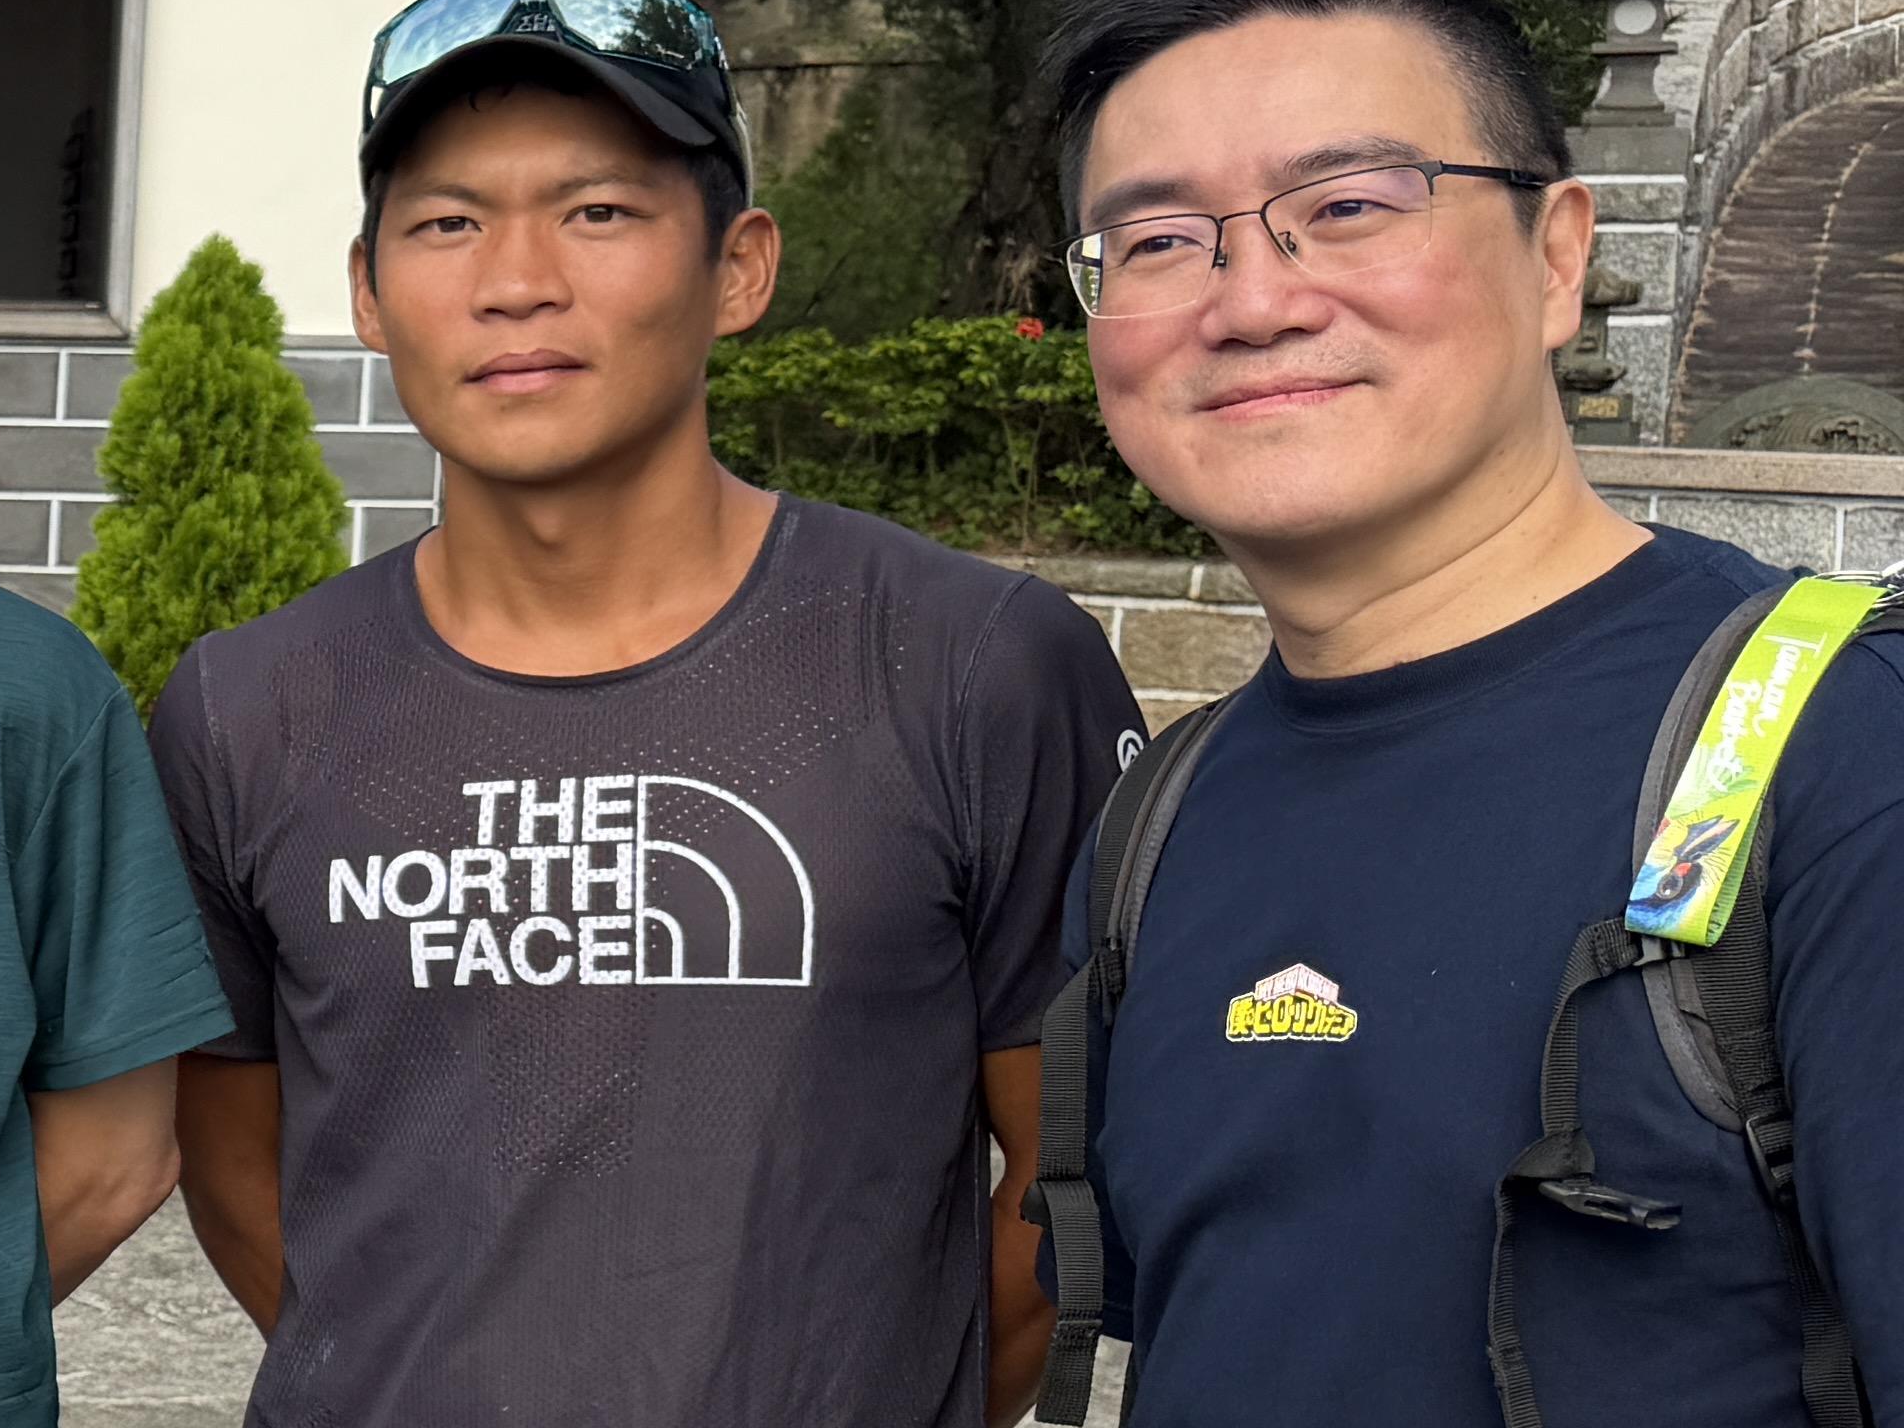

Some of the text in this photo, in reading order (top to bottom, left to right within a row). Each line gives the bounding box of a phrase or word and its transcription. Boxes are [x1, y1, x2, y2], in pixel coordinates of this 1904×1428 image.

[462, 774, 635, 846] THE
[328, 842, 633, 924] NORTH
[408, 915, 633, 988] FACE
